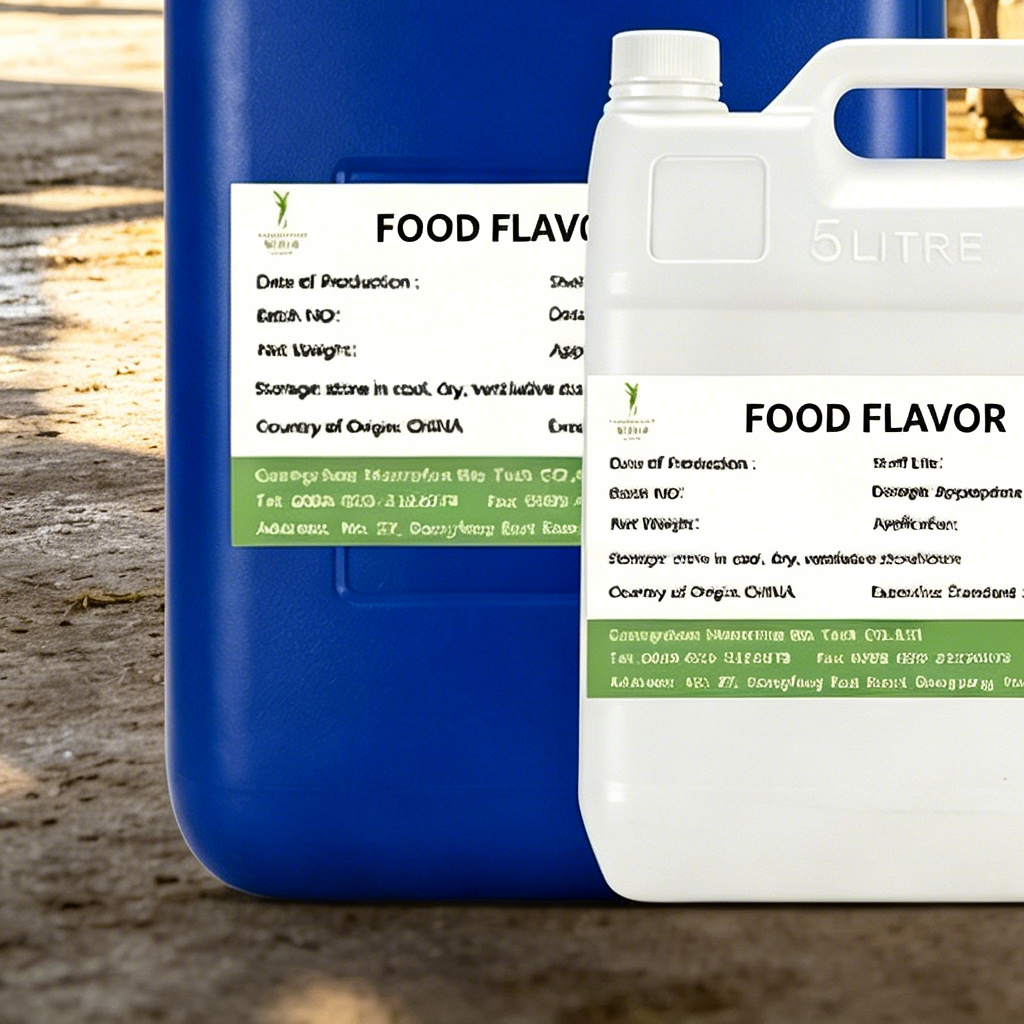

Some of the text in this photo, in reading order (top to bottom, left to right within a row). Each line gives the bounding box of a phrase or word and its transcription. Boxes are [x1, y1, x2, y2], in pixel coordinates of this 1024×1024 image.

[376, 213, 480, 243] FOOD
[811, 219, 984, 264] 5 LITRE
[745, 402, 1007, 434] FOOD FLAVOR
